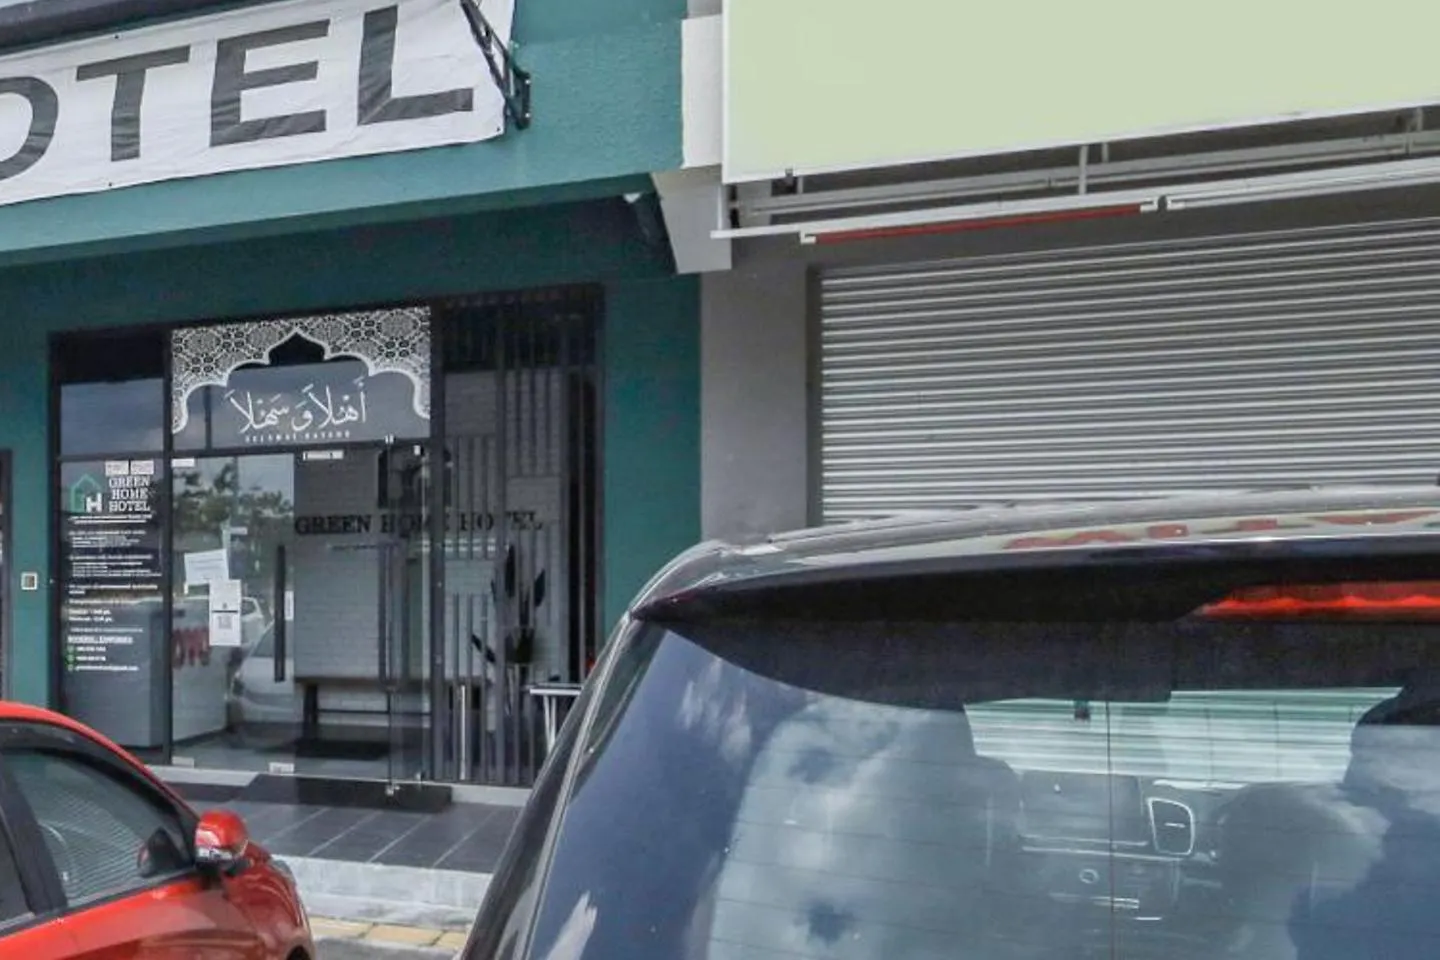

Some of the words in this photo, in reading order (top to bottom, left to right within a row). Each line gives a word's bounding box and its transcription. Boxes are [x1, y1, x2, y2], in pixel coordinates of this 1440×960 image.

[109, 476, 151, 489] GREEN
[112, 487, 148, 500] HOME
[109, 500, 151, 513] HOTEL
[294, 514, 371, 535] GREEN
[459, 510, 543, 532] HOEL
